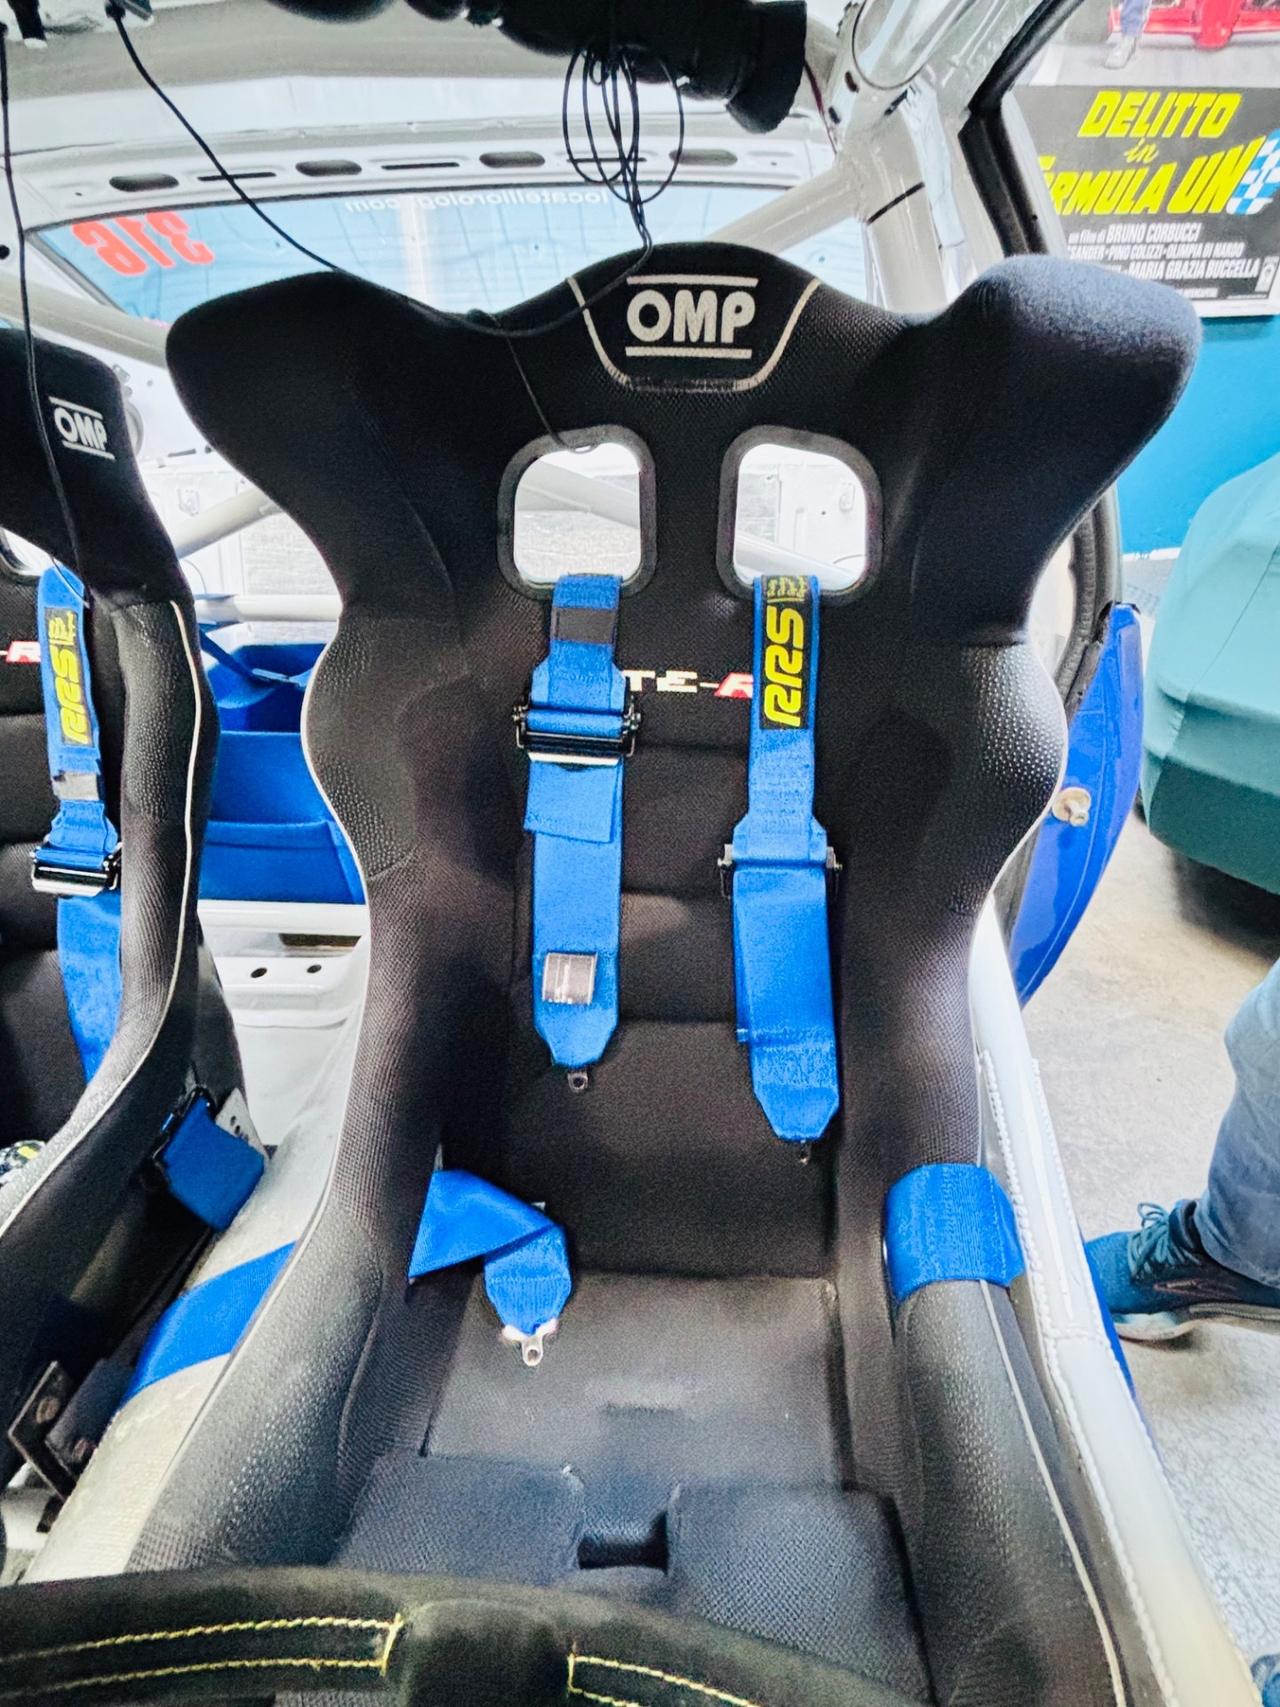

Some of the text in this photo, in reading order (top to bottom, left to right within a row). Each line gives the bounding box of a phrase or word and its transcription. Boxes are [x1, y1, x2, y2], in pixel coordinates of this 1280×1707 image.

[1077, 90, 1242, 138] DELITTO
[1124, 138, 1159, 163] in
[1038, 156, 1178, 216] RMULA
[1106, 223, 1147, 243] BRUNO
[1146, 222, 1202, 243] CORBUCCI
[1130, 243, 1164, 260] COLIZZI
[1166, 243, 1203, 259] OLIMPIA
[1128, 260, 1167, 280] MARIA
[1165, 259, 1208, 280] GRAZIA
[1204, 257, 1260, 279] BUCCELLA
[627, 289, 756, 344] OMP
[54, 407, 108, 452] OMP
[764, 605, 804, 727] RRS
